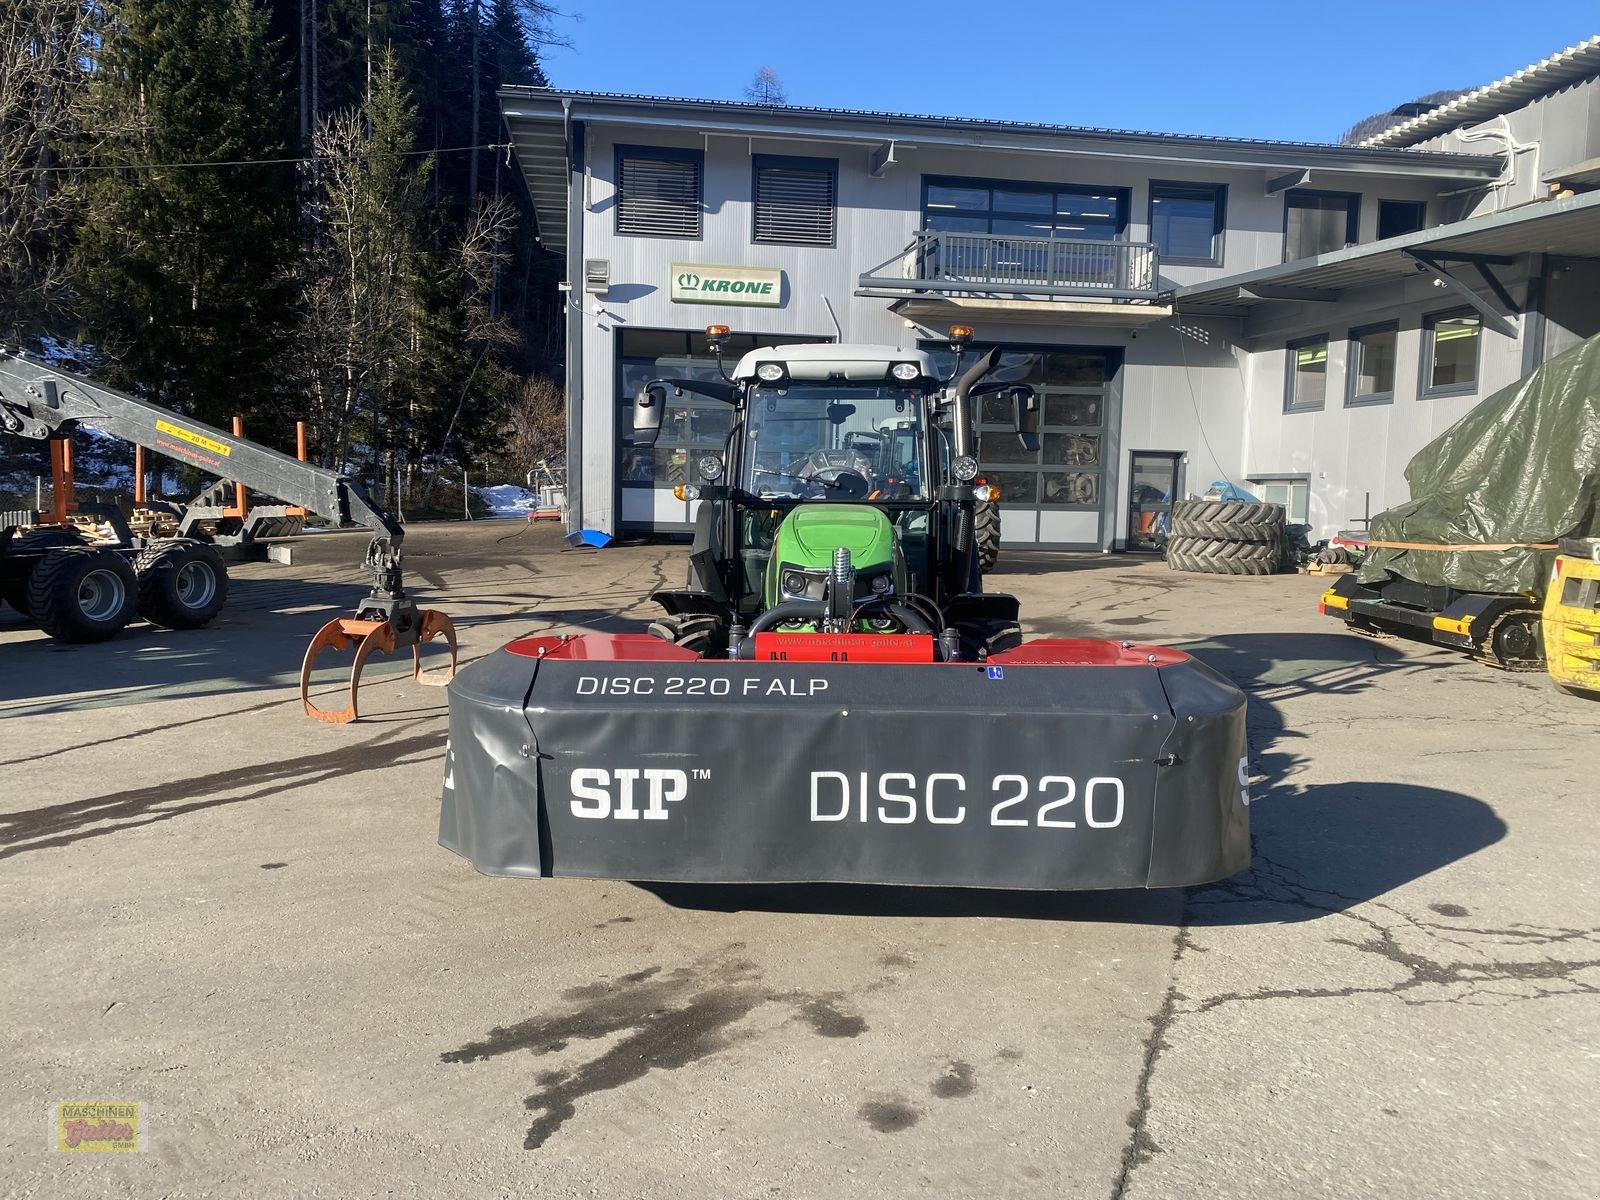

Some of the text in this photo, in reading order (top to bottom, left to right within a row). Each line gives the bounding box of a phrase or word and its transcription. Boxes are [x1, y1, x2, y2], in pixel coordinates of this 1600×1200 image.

[701, 279, 773, 294] KRONE
[191, 435, 200, 443] 20
[576, 676, 829, 696] DISC 220 F ALP
[569, 767, 688, 821] SIP
[810, 770, 1125, 829] DISC 220
